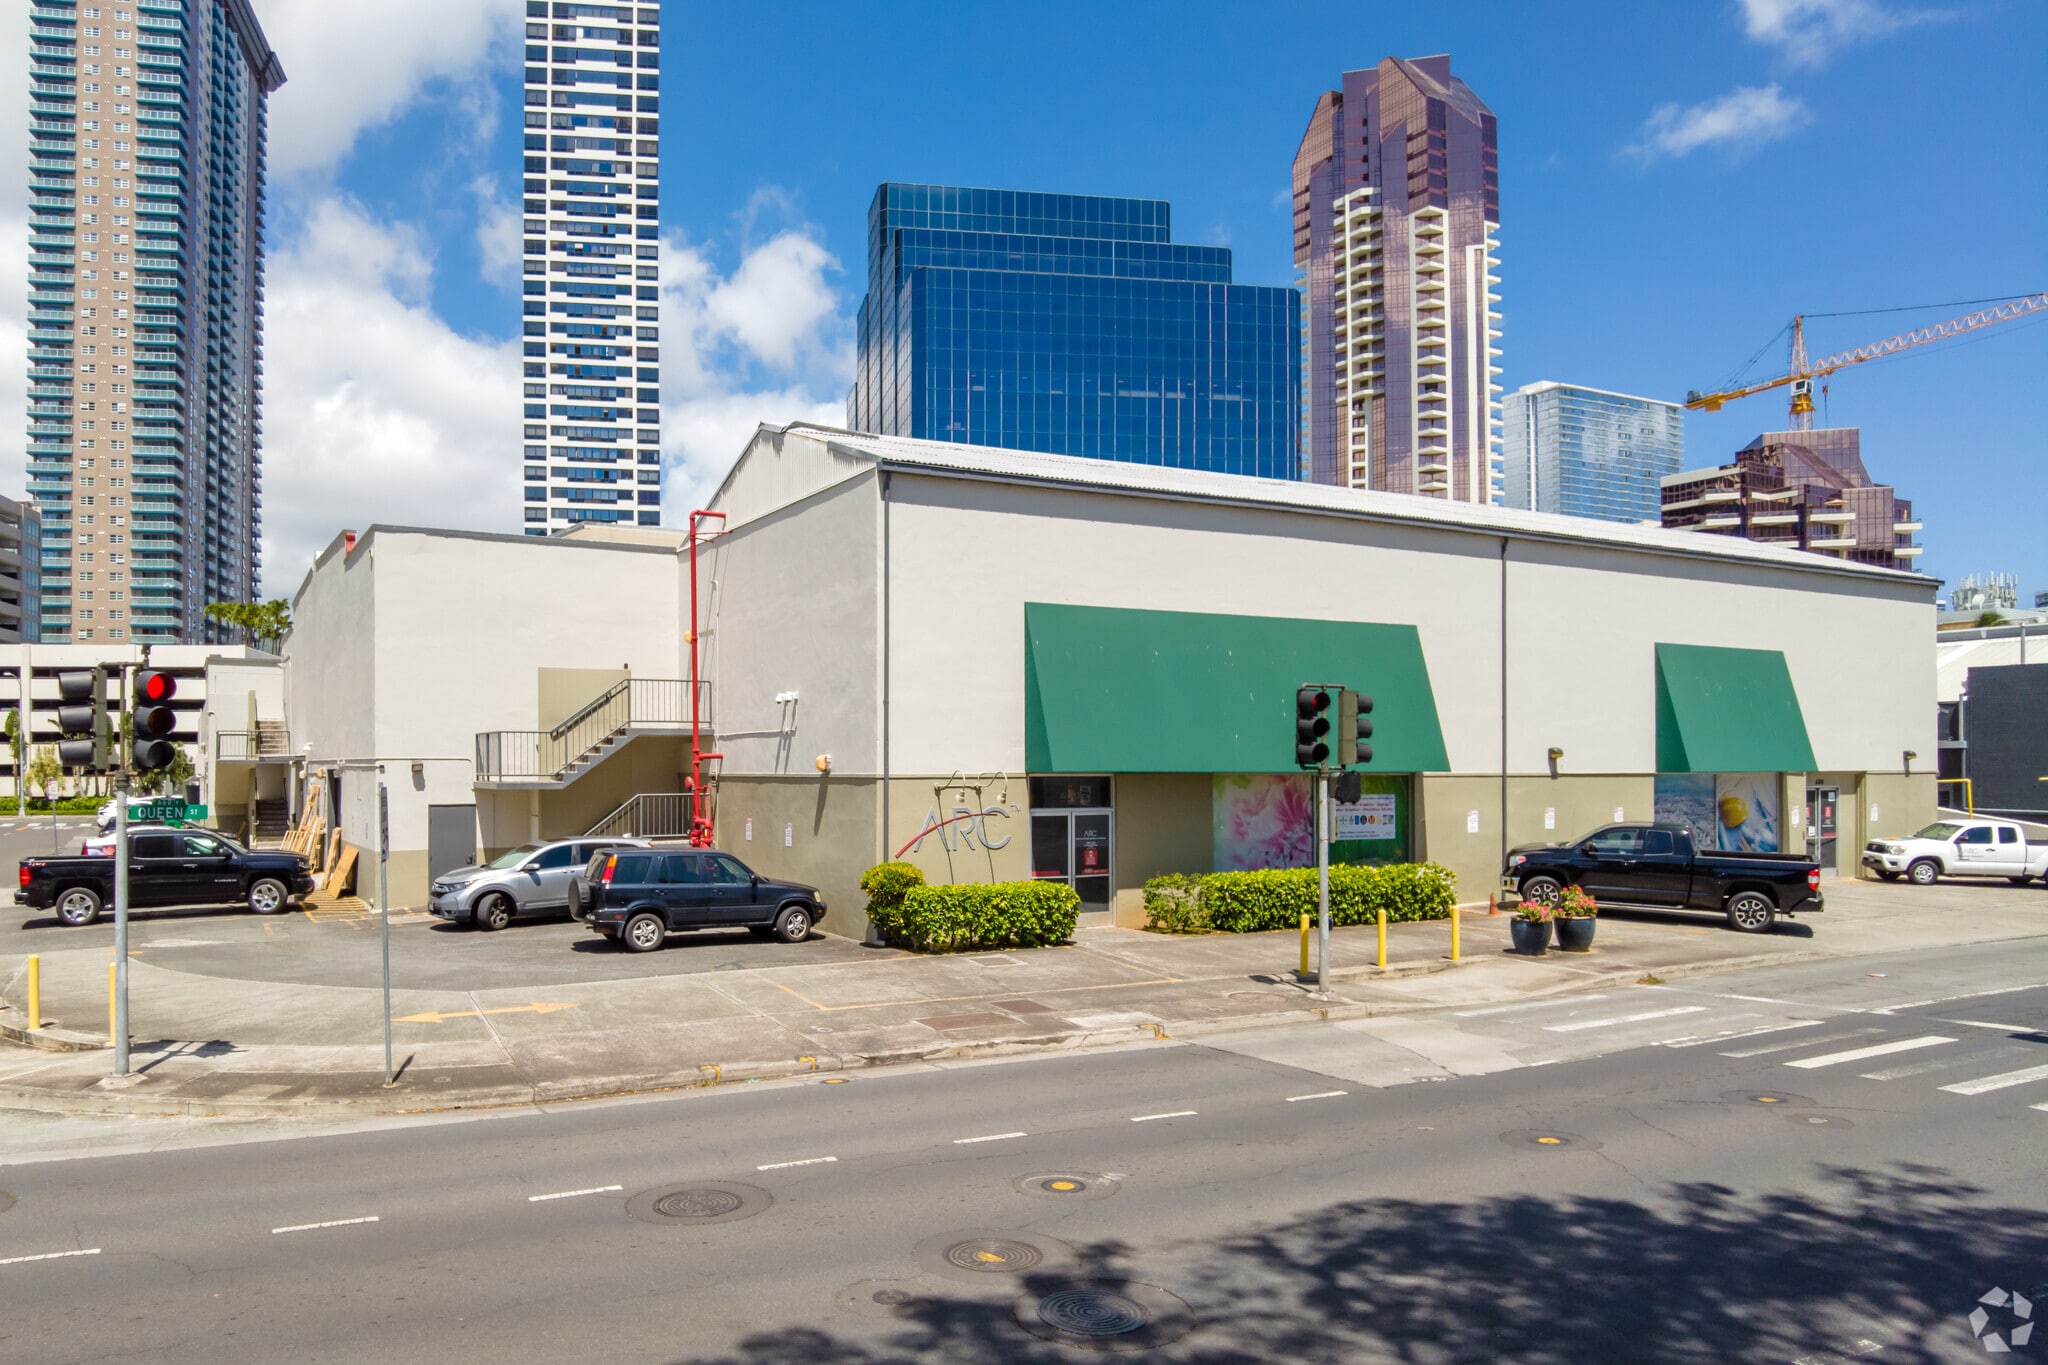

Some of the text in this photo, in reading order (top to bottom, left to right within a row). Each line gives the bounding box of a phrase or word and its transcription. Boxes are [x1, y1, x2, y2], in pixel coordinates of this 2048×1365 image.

[138, 807, 198, 819] QUEEN ST
[913, 806, 1012, 852] ARC
